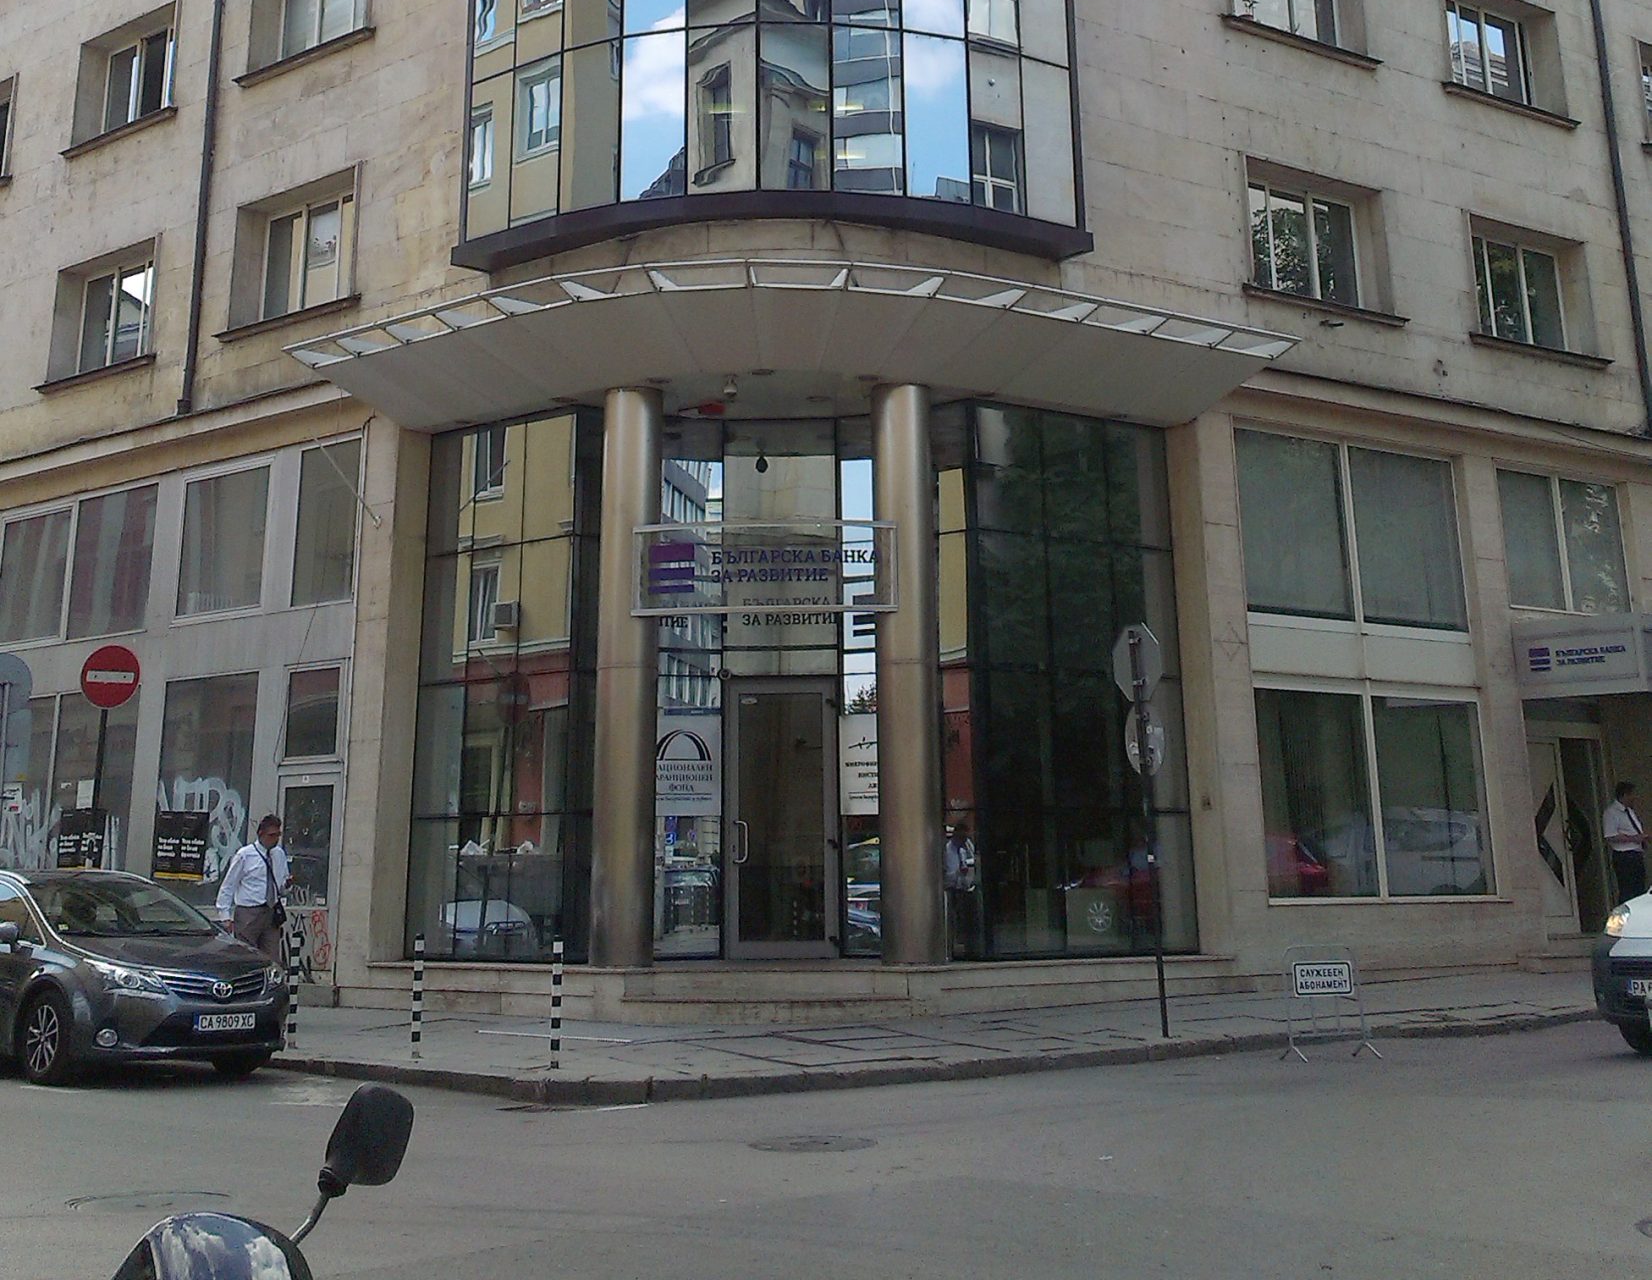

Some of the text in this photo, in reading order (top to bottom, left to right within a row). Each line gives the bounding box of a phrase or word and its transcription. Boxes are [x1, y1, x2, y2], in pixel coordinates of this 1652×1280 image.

[711, 549, 880, 565] БЪЛГАРСКА БАНКА
[711, 568, 829, 584] ЗА РАЗВИТИЕ
[742, 614, 760, 626] ЗА
[1300, 968, 1344, 978] СЛУЖЕБЕН
[1299, 979, 1348, 990] АБОНАМЕНТ
[200, 1014, 254, 1029] CA 9809 XC
